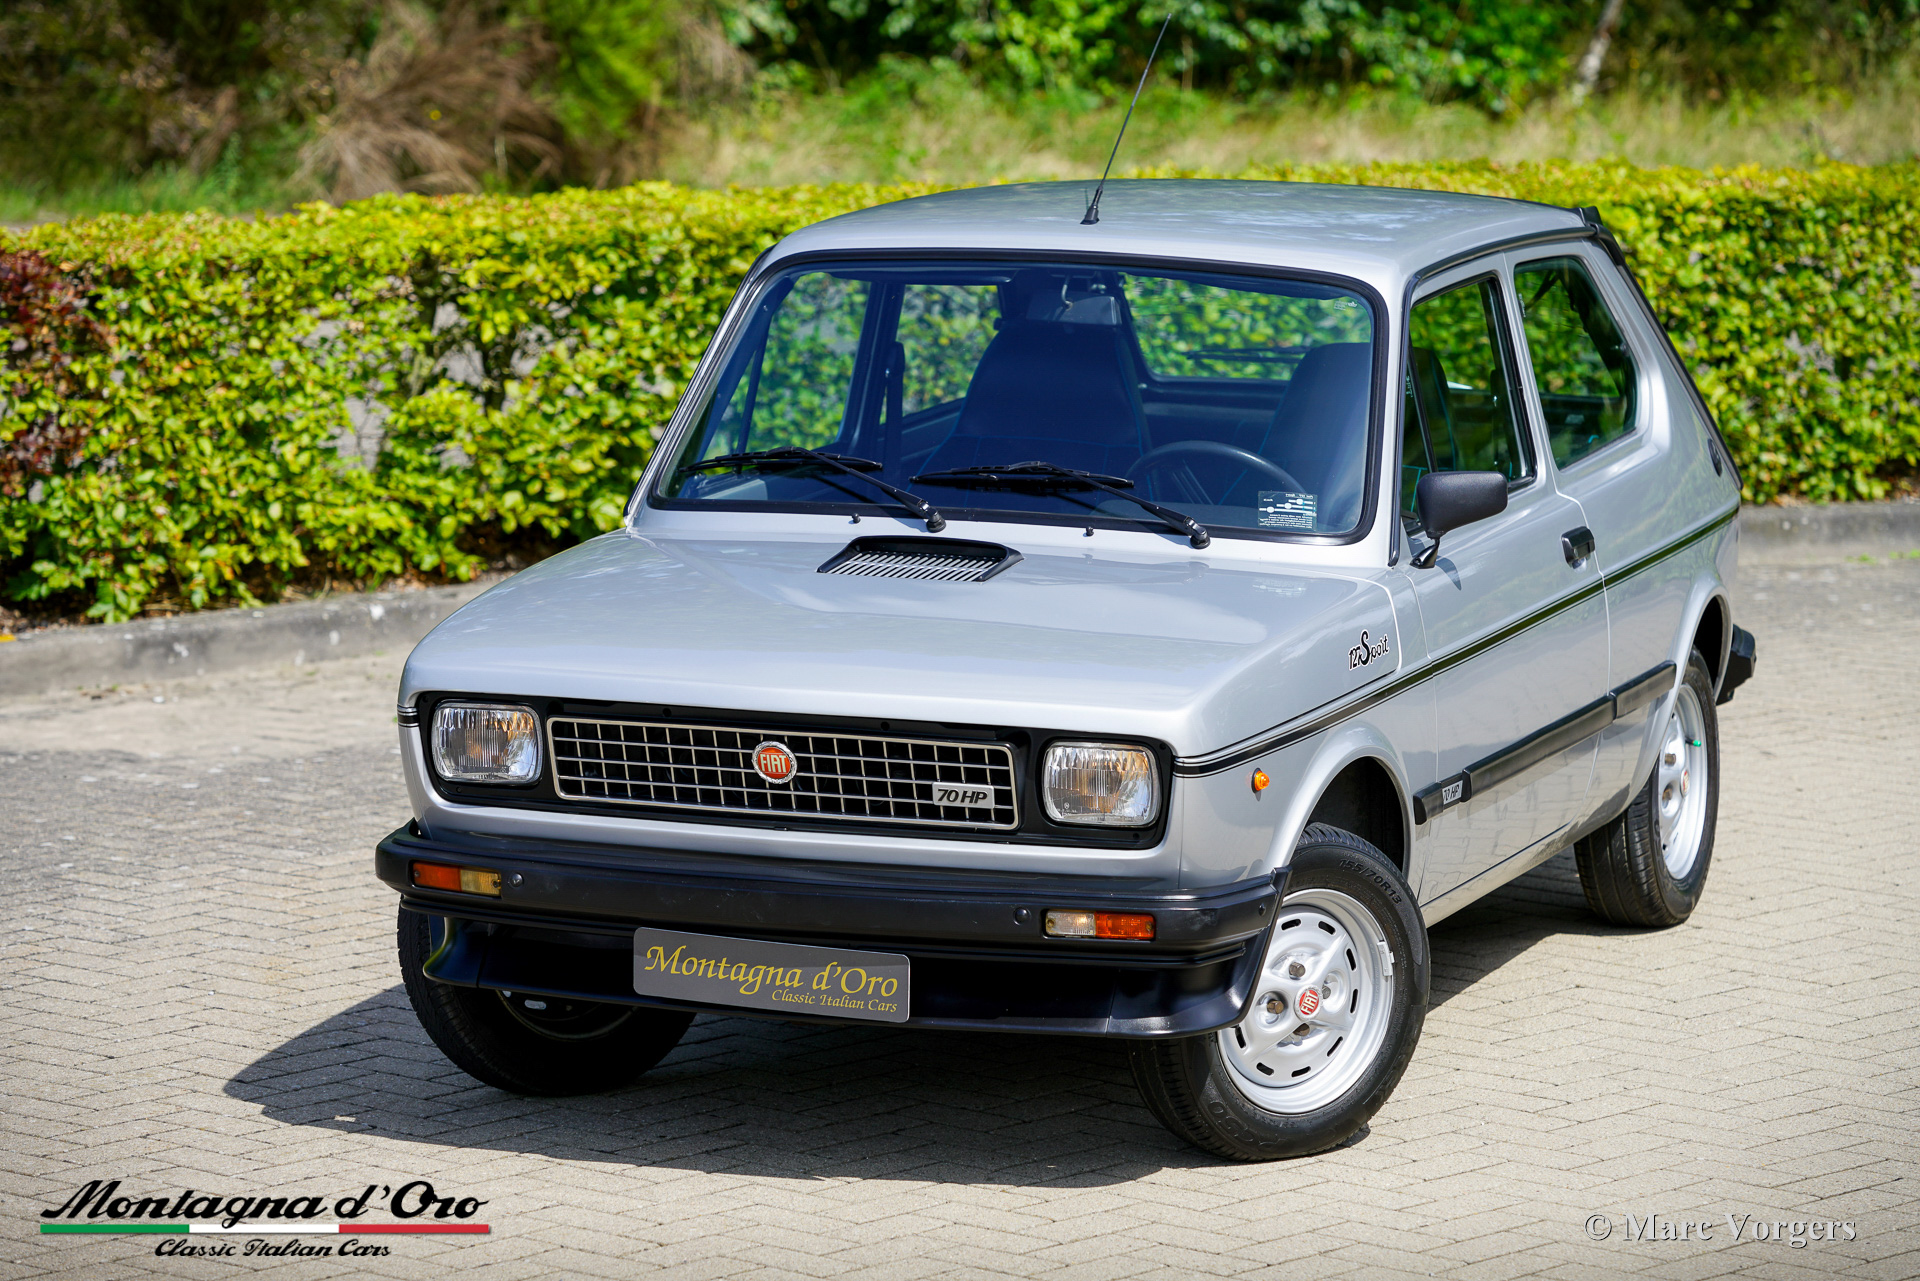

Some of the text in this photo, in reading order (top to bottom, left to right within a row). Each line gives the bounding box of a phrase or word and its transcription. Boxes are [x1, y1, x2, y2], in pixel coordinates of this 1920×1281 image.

[759, 753, 787, 773] FIAT
[937, 788, 988, 804] 70 HP
[644, 945, 898, 997] Montagna d'Oro
[771, 988, 898, 1013] Classic Italian Cars
[1300, 990, 1318, 1015] FIAT
